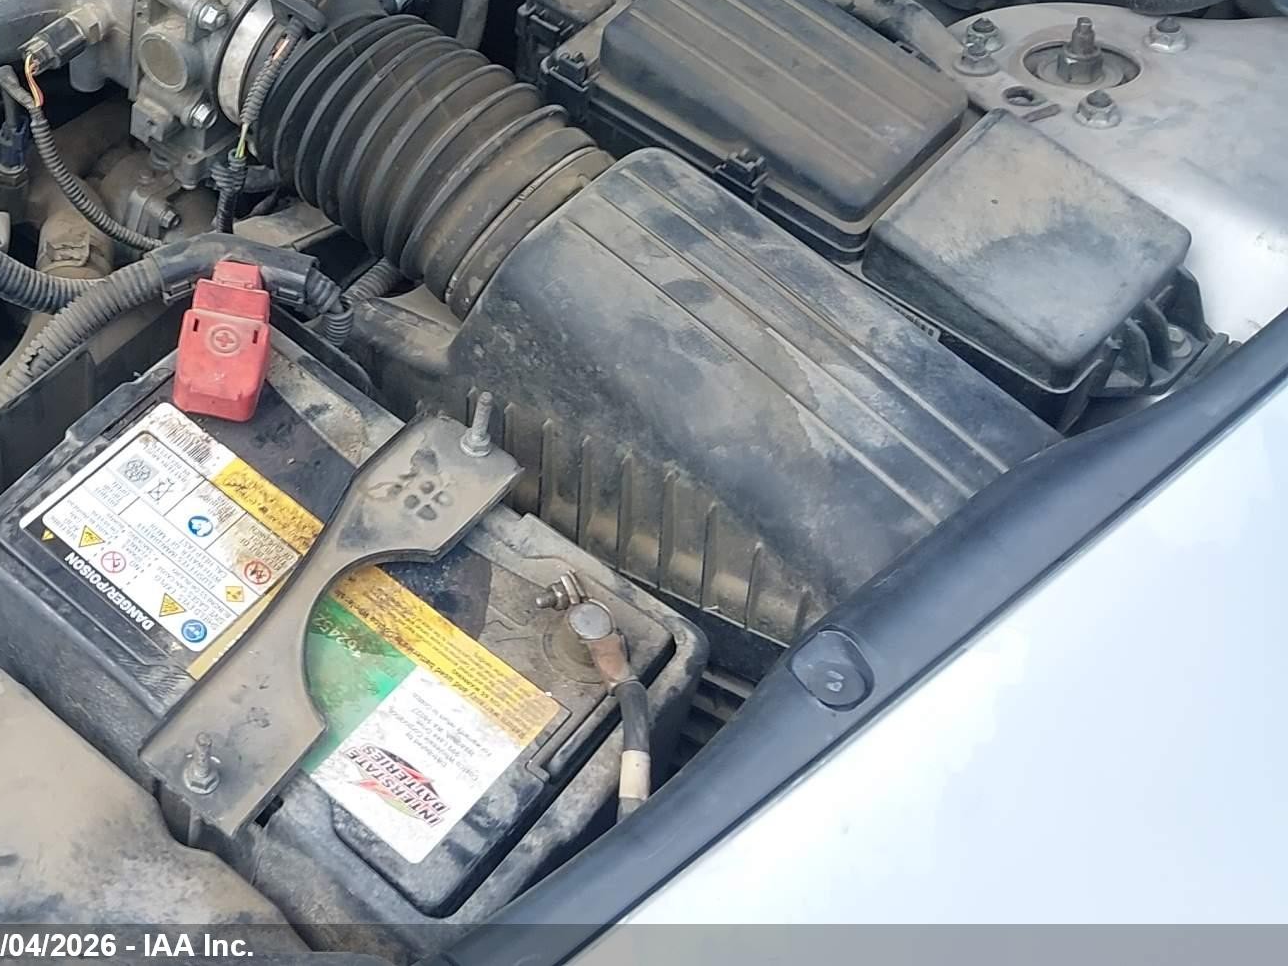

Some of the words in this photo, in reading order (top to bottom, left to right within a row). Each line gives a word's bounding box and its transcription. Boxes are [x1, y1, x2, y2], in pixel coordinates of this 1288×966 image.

[62, 550, 156, 630] DANGER/POISON
[431, 664, 455, 684] used
[450, 679, 469, 695] and
[343, 747, 441, 826] INTERSTATE
[359, 742, 448, 813] BATTERIES
